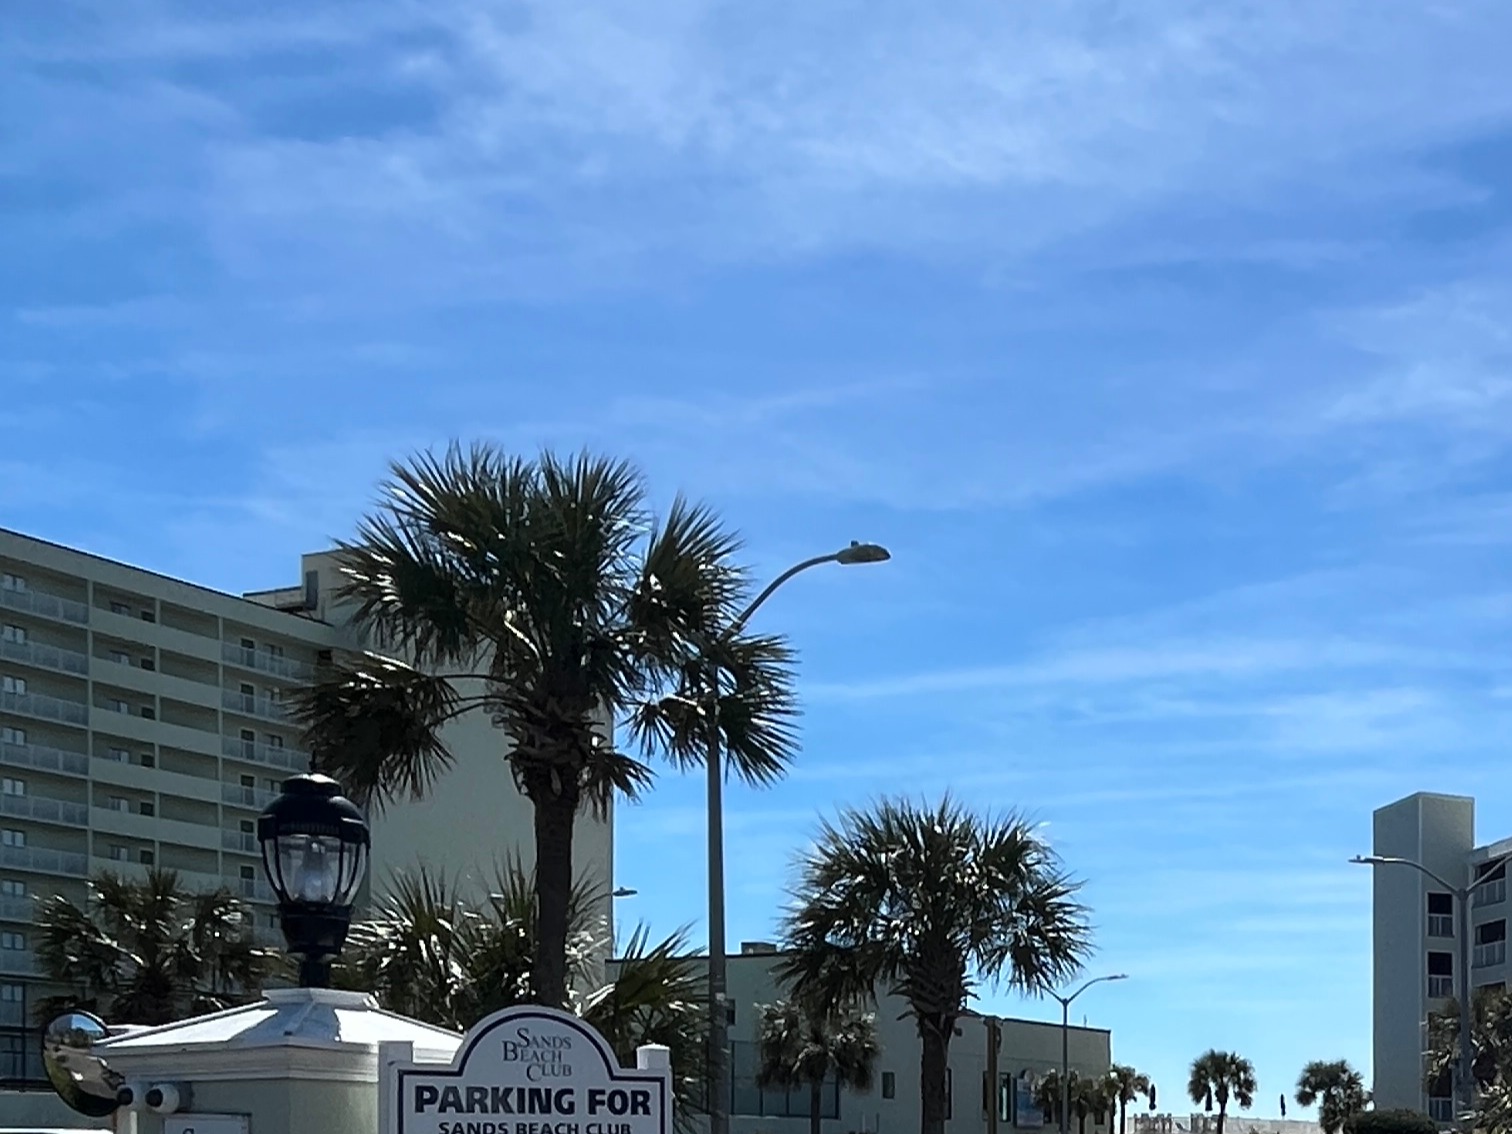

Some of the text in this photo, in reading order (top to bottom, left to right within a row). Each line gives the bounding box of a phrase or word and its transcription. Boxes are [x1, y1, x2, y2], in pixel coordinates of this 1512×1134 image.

[516, 1027, 572, 1050] SANDS
[502, 1041, 562, 1063] BEACH
[526, 1063, 572, 1082] CLUB
[414, 1085, 651, 1116] PARKING FOR
